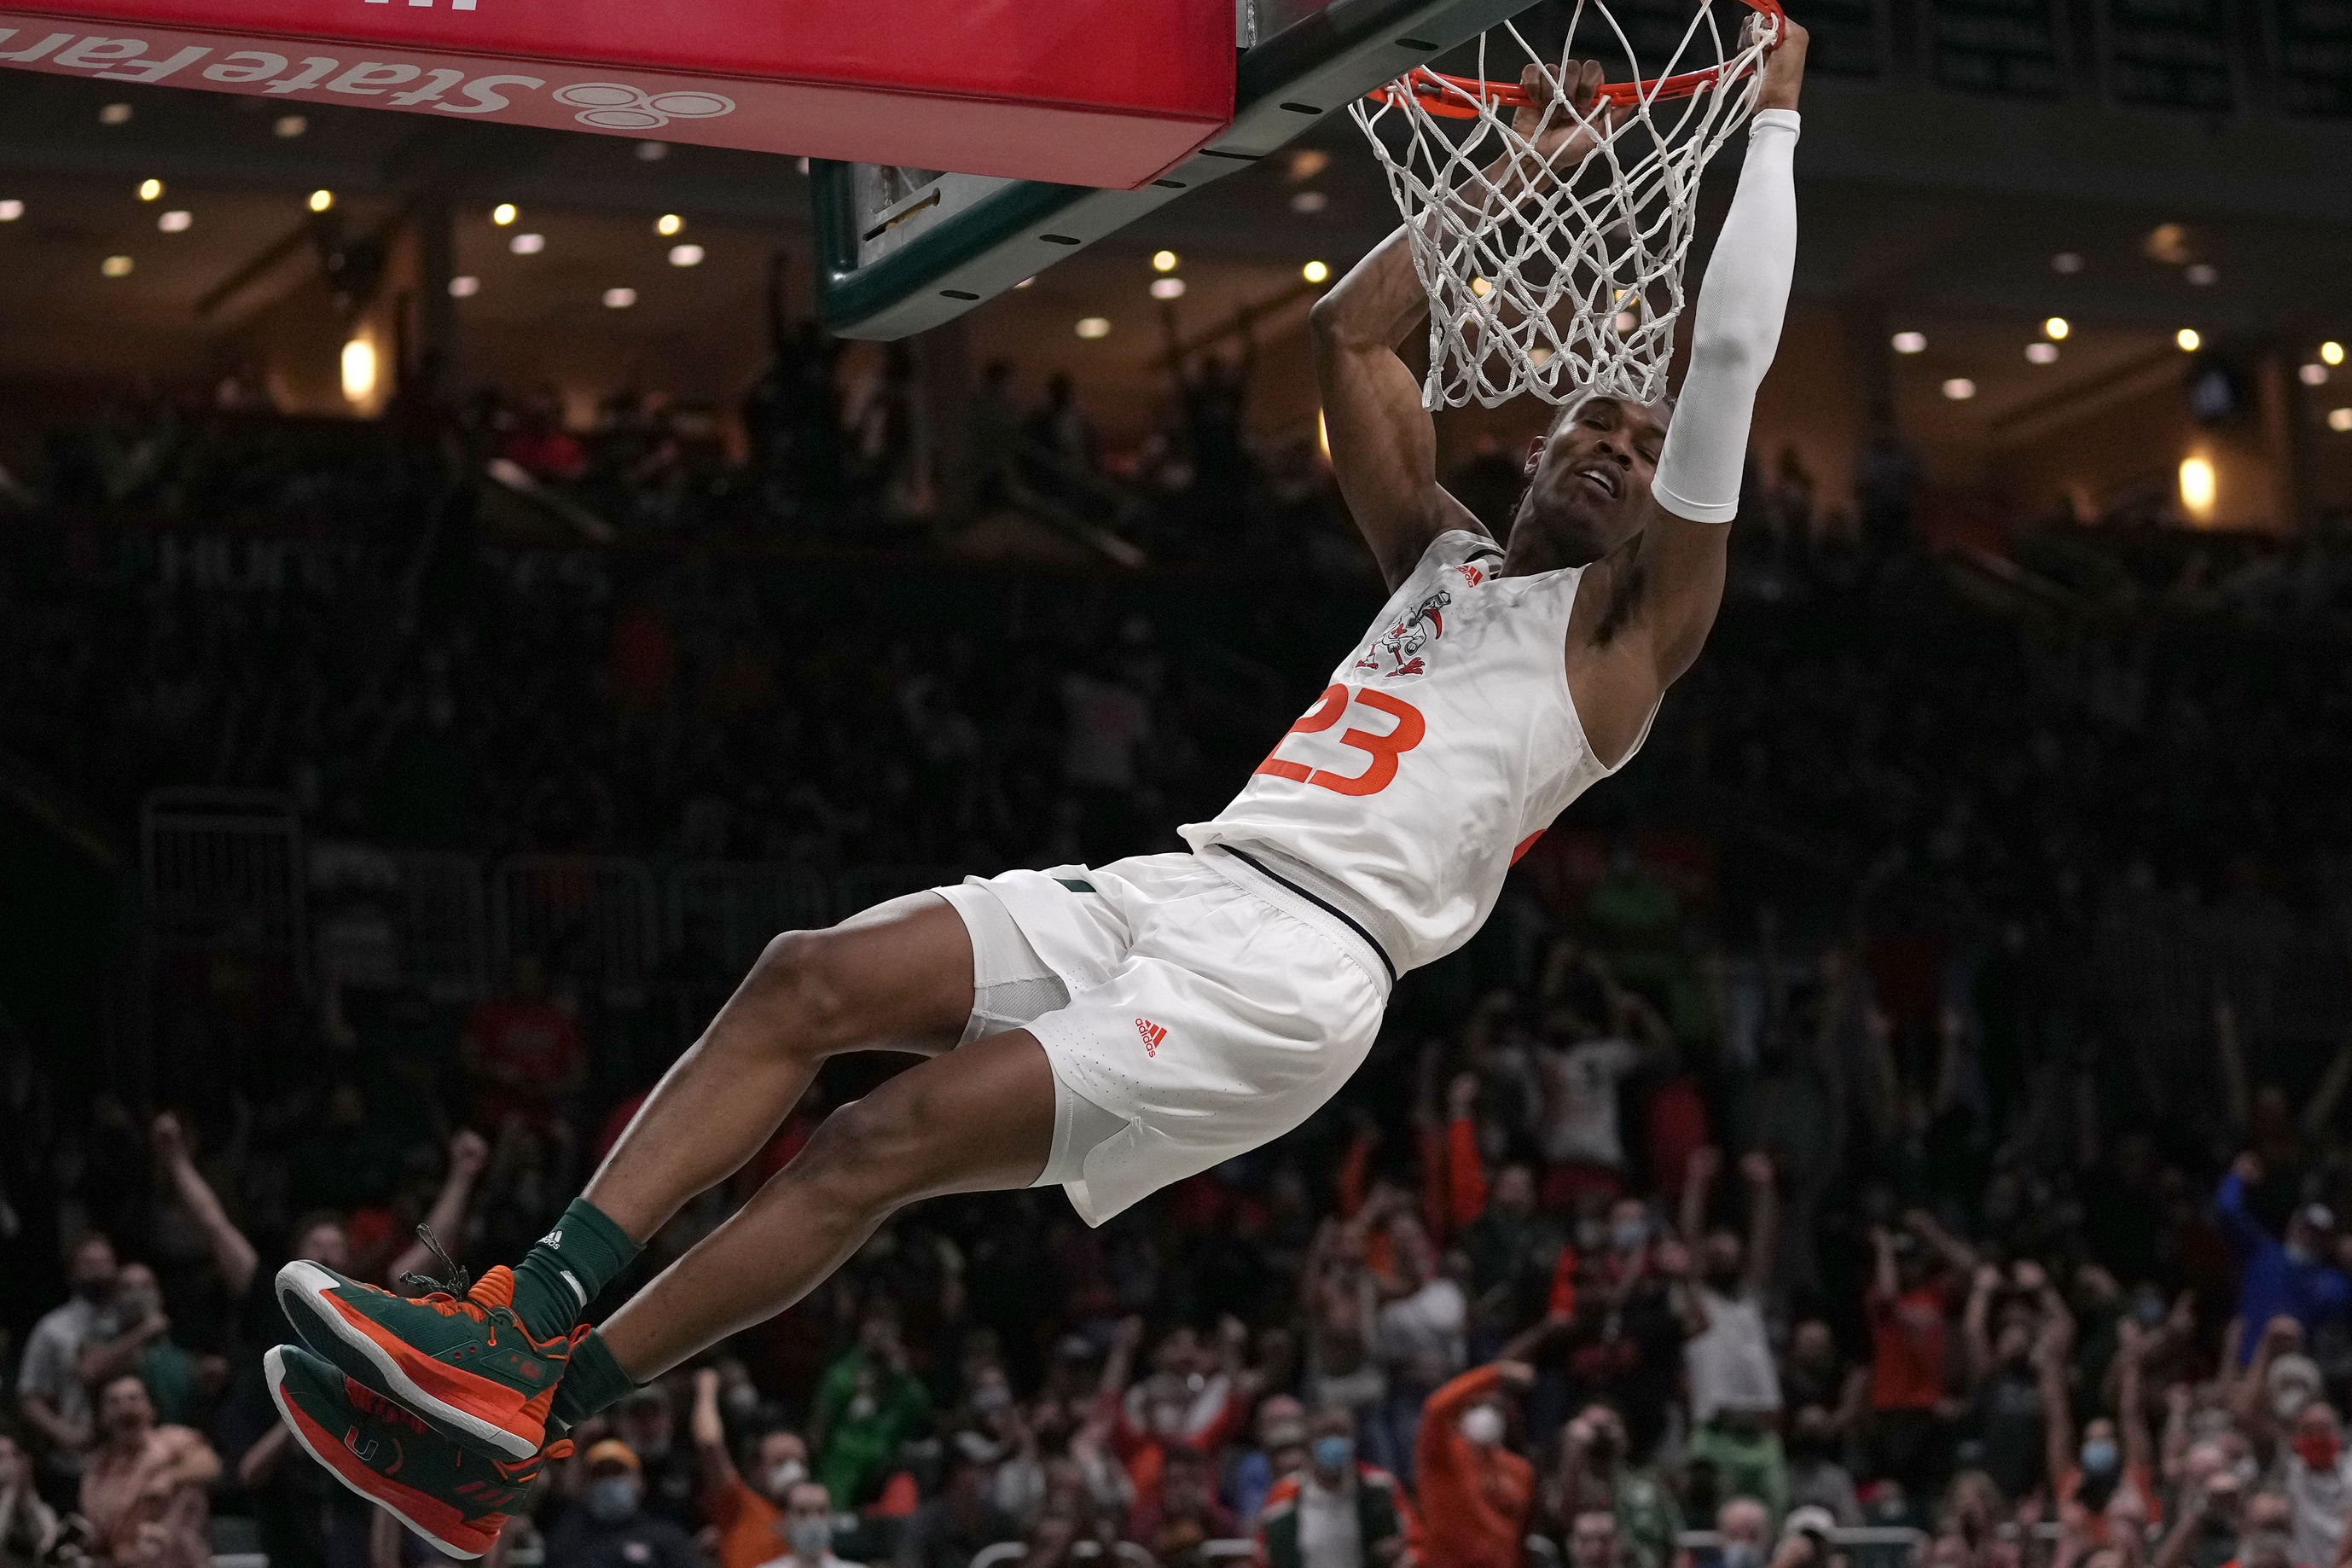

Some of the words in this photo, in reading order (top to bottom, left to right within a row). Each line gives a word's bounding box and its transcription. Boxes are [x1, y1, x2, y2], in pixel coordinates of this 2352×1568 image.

[1253, 683, 1426, 796] 23
[1135, 1018, 1156, 1058] adidas
[344, 1424, 379, 1461] U
